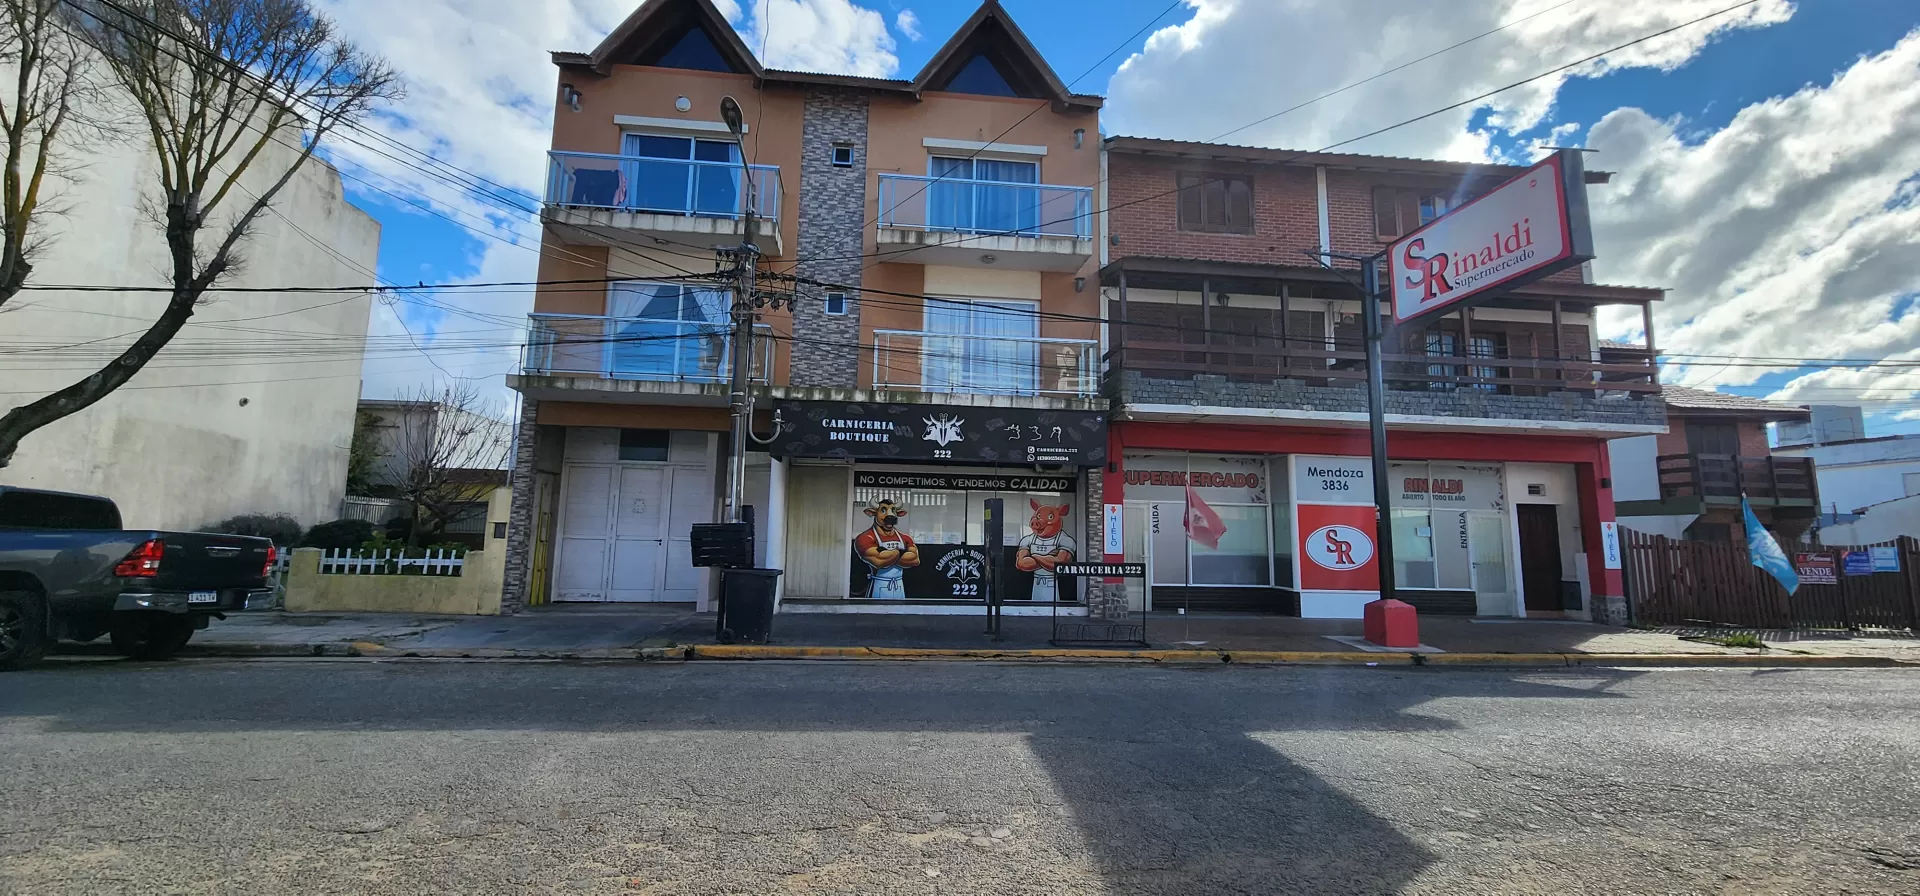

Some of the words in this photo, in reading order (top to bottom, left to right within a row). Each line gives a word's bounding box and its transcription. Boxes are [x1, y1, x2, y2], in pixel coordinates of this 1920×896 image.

[1454, 249, 1534, 289] Supermercado
[822, 418, 894, 430] CARNICERIA
[829, 431, 890, 442] BOUTIQUE
[934, 449, 952, 458] 222
[1307, 466, 1364, 478] Mendoza
[859, 475, 875, 484] NO
[878, 476, 948, 487] COMPETIMOS,
[951, 479, 1006, 488] VENDEMOS
[1010, 478, 1068, 490] CALIDAD
[1322, 480, 1349, 491] 3836
[1404, 478, 1463, 493] RINALDI
[1152, 504, 1160, 534] SALIDA
[1110, 516, 1118, 547] HIELO
[1459, 511, 1468, 549] ENTRADA
[1325, 529, 1356, 565] SR
[1607, 532, 1617, 562] HIELO
[935, 548, 965, 571] CARNICERIA
[1056, 565, 1124, 574] CARNICERIA
[1125, 565, 1142, 574] 222
[1800, 567, 1833, 576] VENDE
[952, 583, 978, 595] 222
